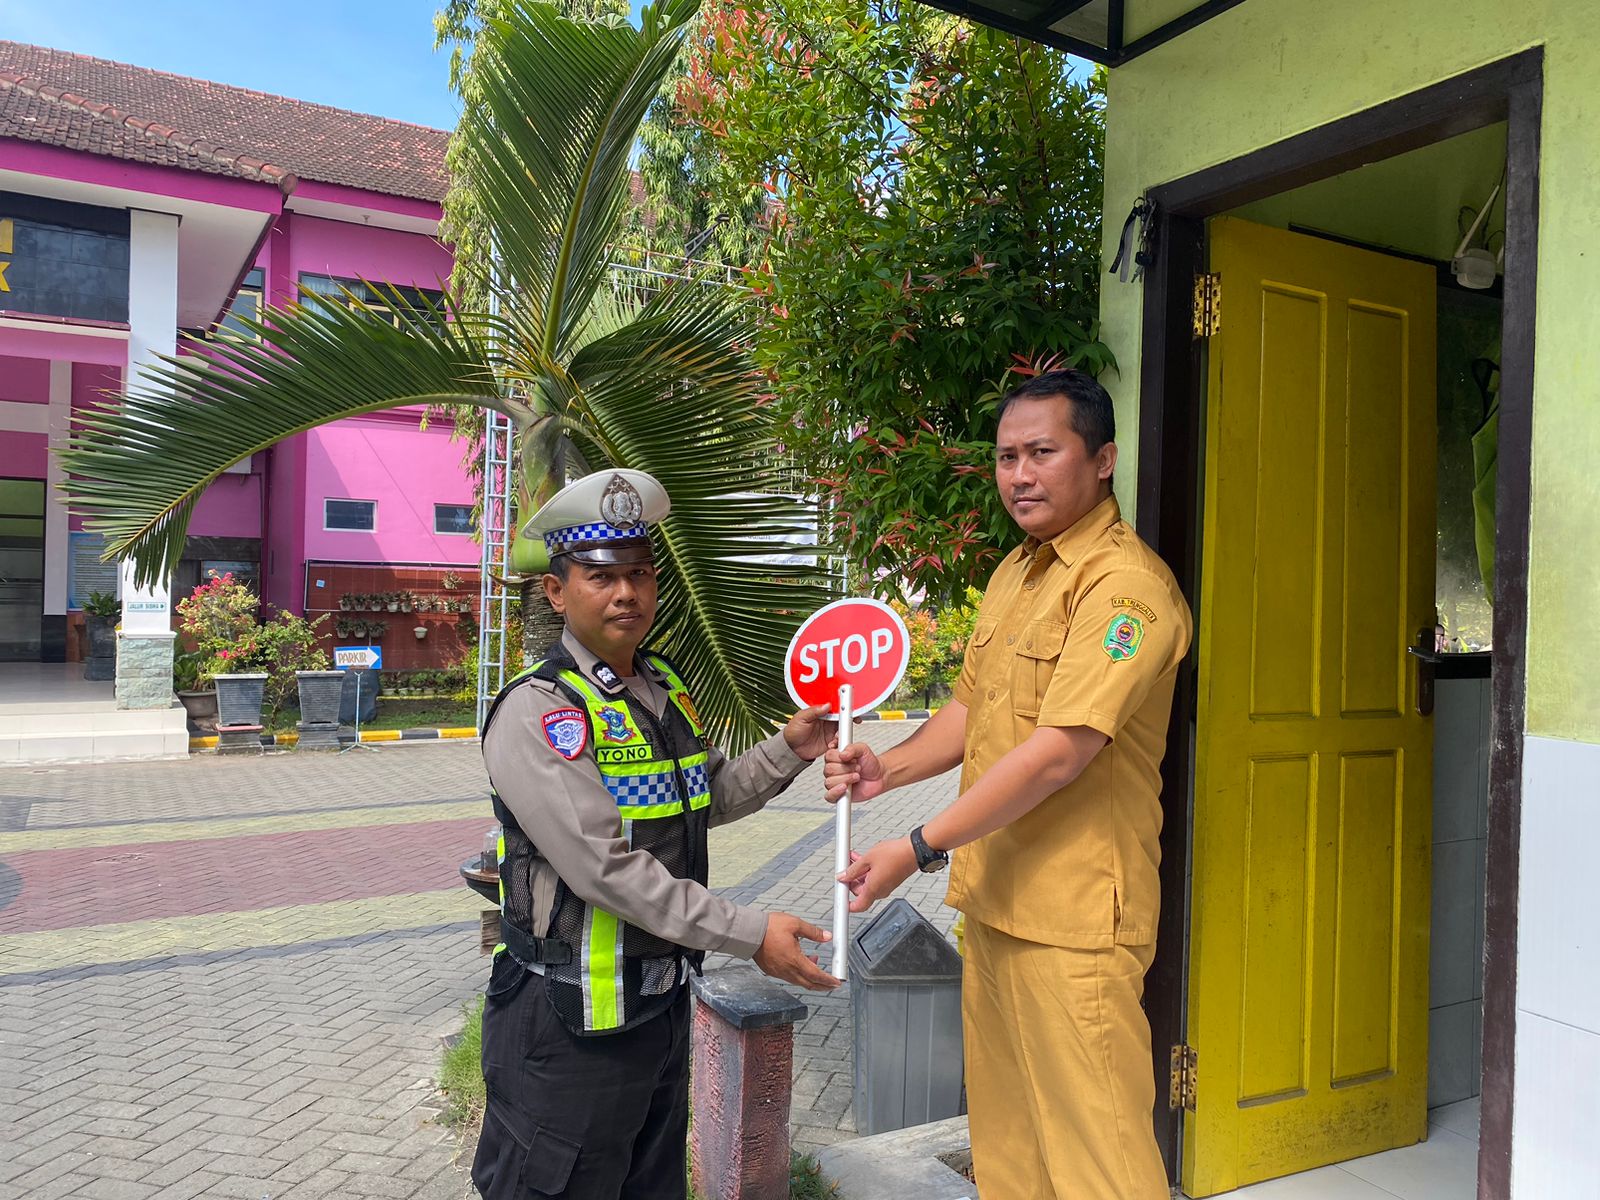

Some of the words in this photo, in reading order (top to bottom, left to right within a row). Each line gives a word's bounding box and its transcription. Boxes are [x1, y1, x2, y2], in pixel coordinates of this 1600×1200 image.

[337, 651, 368, 664] PARKIR
[799, 627, 894, 684] STOP
[545, 712, 560, 722] LALU
[561, 711, 582, 719] LINTAS
[600, 747, 647, 761] YONO
